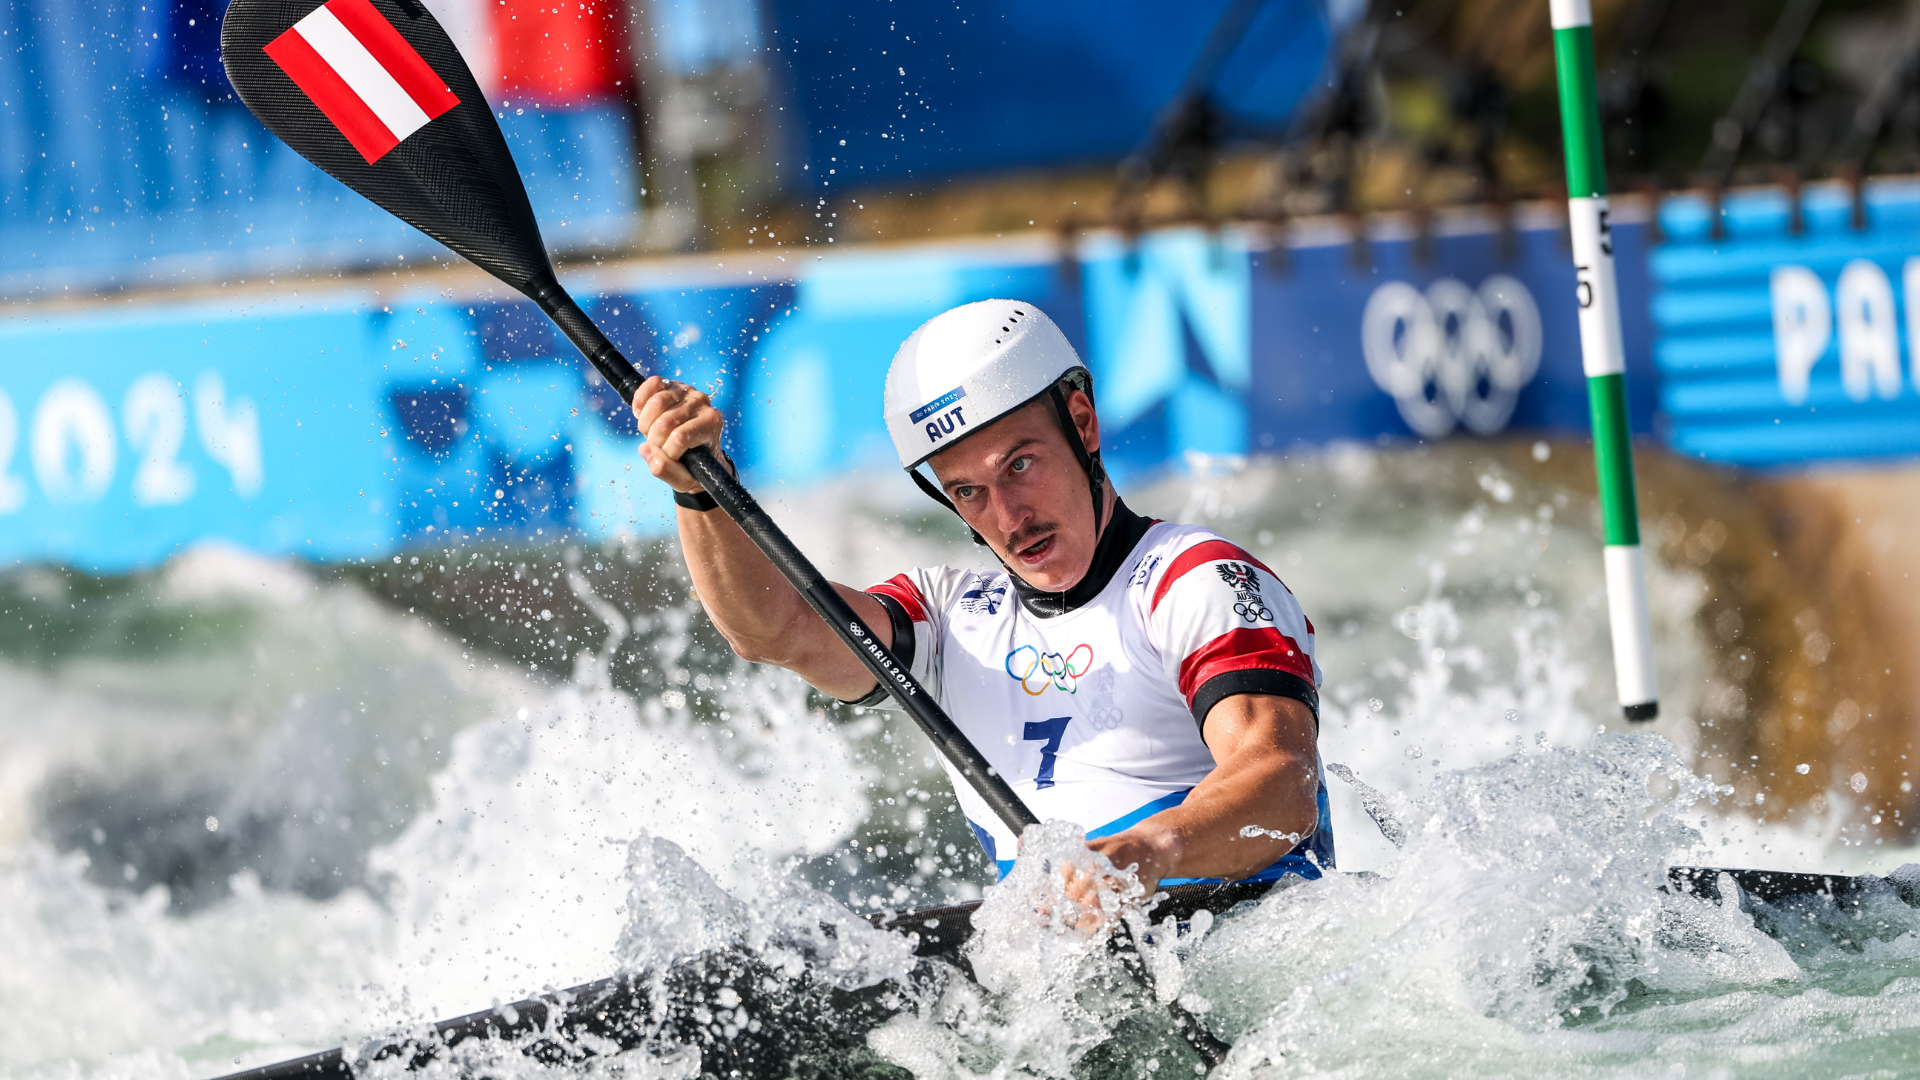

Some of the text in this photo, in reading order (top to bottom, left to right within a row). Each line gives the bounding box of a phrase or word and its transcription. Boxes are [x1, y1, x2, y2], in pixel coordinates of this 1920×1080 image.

[923, 393, 958, 414] PARIS 2024
[925, 406, 966, 443] AUT
[1236, 592, 1264, 605] AUSIA
[863, 637, 917, 696] PARIS 2024
[1022, 716, 1072, 790] 7
